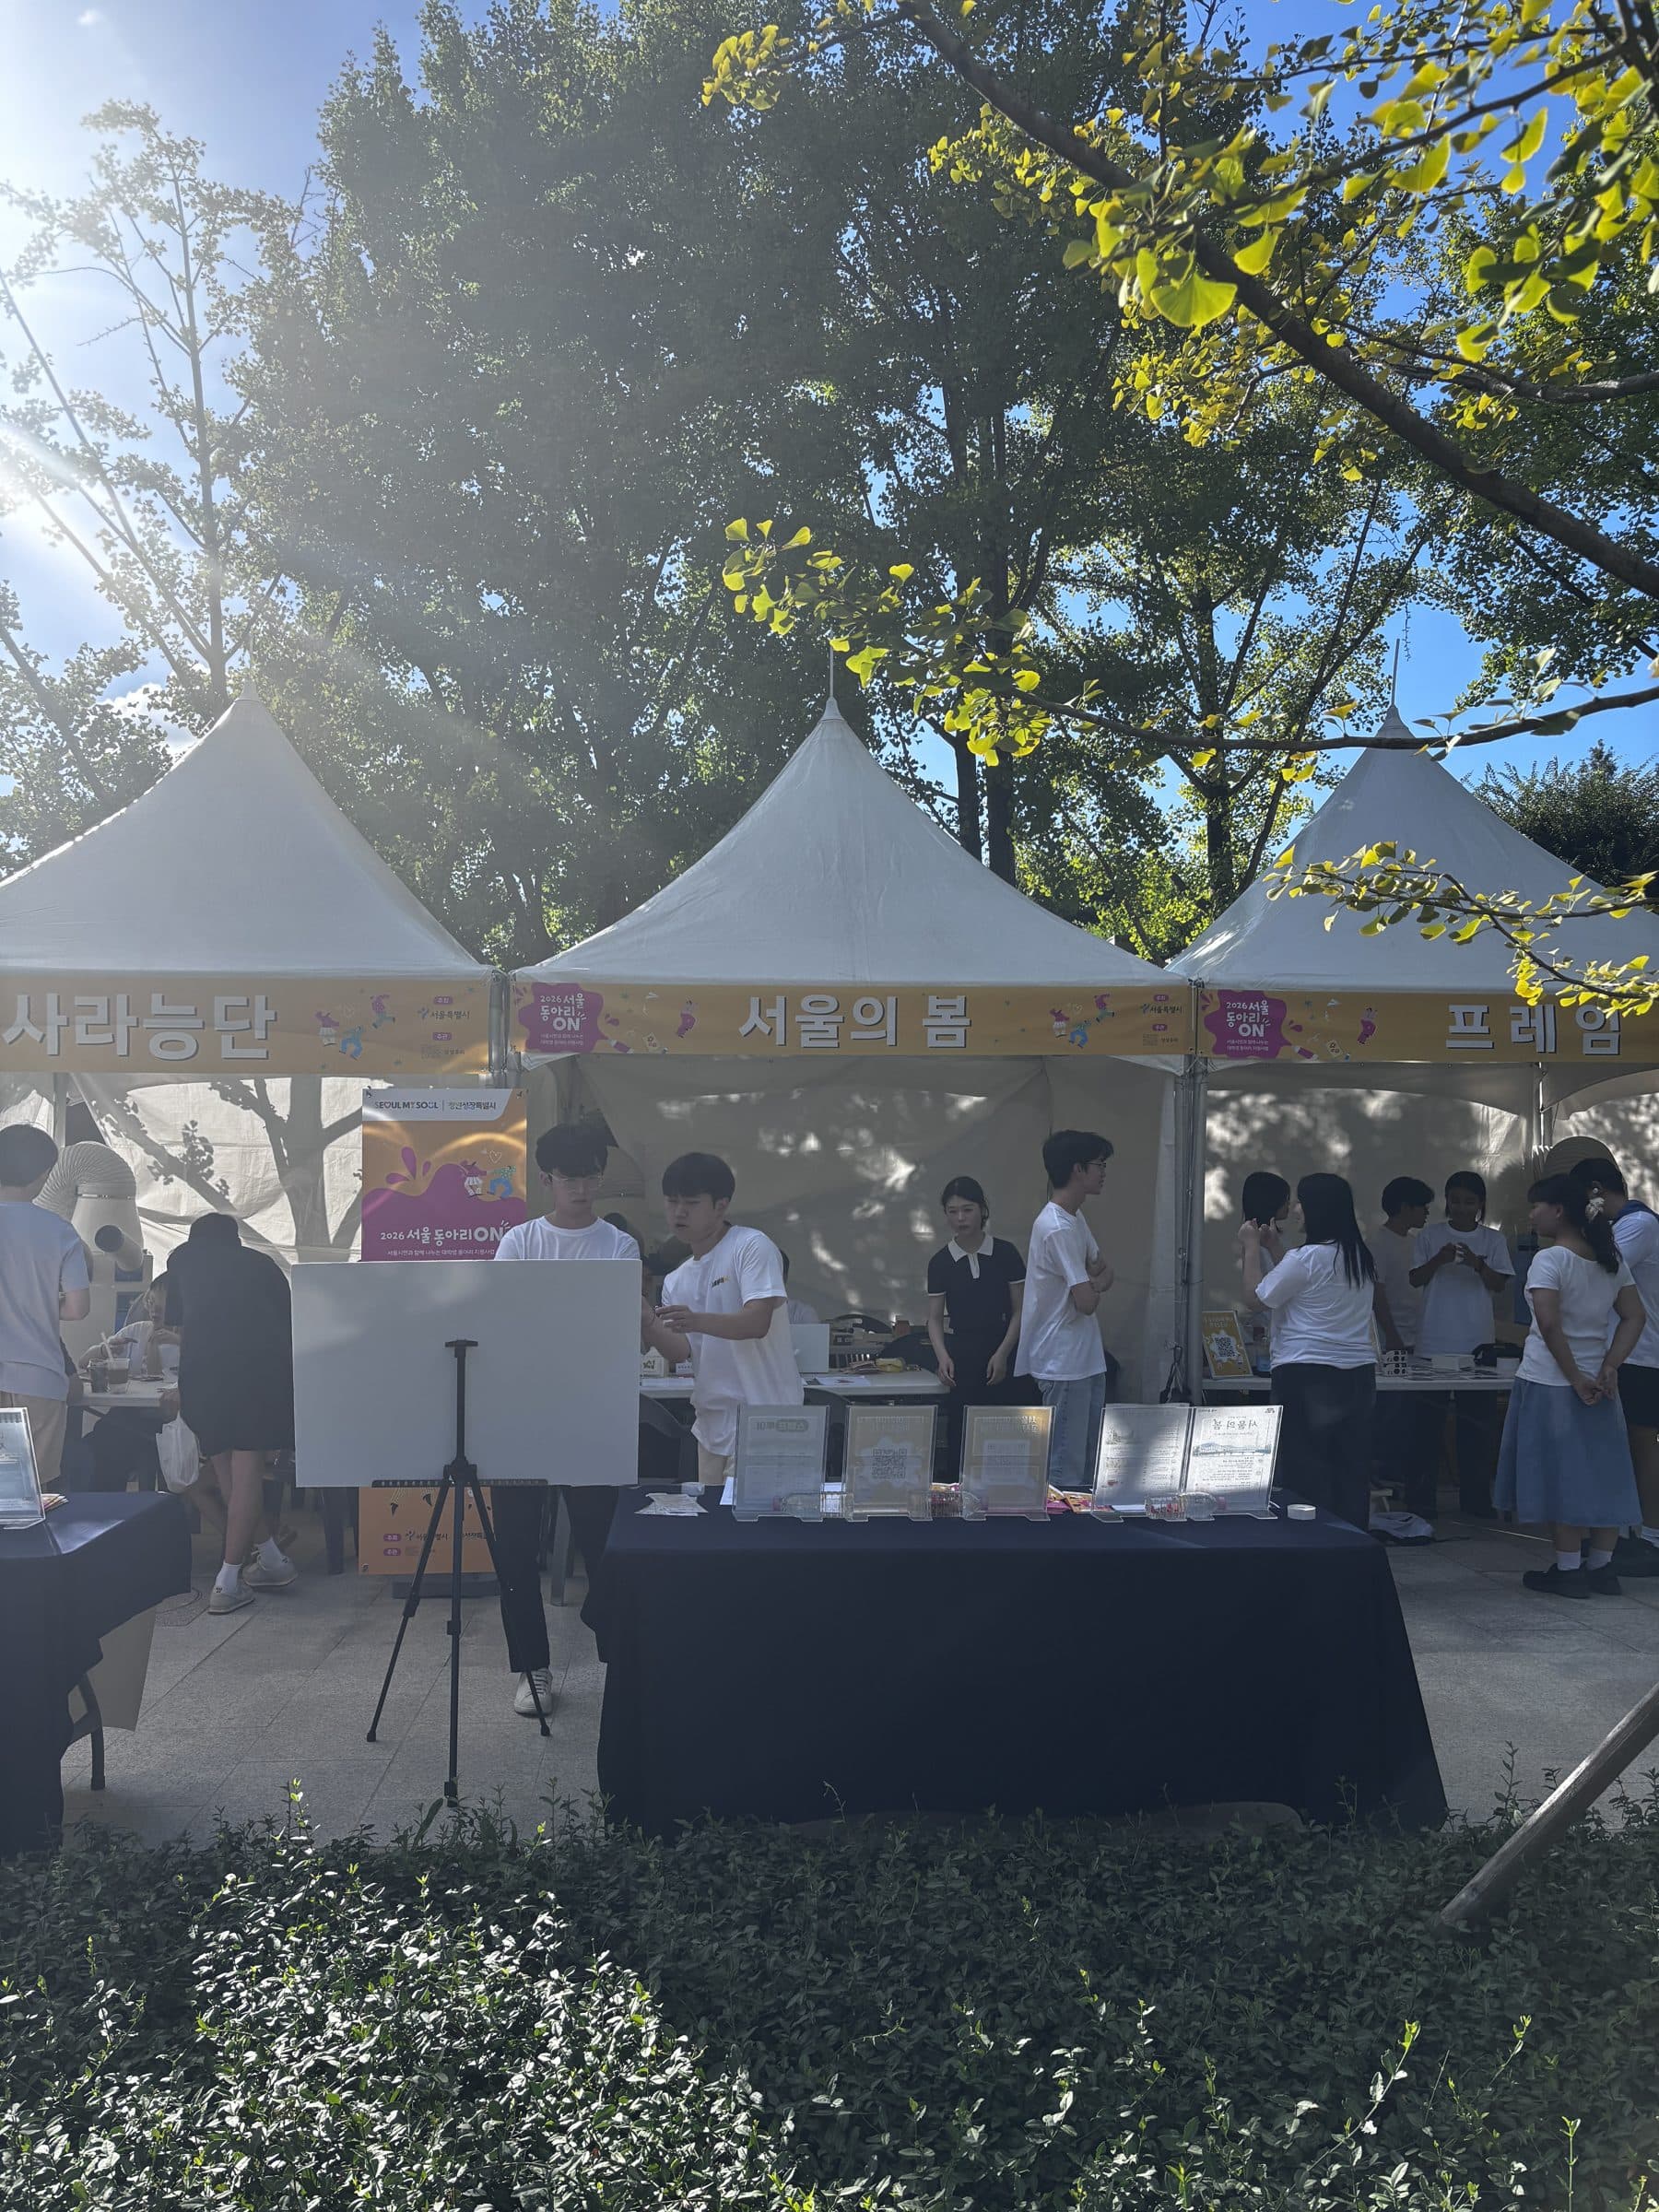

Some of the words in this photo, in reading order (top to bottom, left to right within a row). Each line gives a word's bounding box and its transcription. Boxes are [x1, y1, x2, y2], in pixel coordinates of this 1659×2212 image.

[540, 994, 562, 1004] 2026
[563, 992, 585, 1009] 서울
[1226, 1001, 1248, 1009] 2026
[1248, 999, 1269, 1016] 서울
[540, 1005, 575, 1022] 동아리
[739, 994, 899, 1049] 서울의
[922, 994, 972, 1049] 봄
[1226, 1011, 1260, 1029] 동아리
[2, 993, 276, 1061] 사라능단
[552, 1017, 581, 1031] ON
[1238, 1023, 1265, 1038] ON
[1445, 1003, 1620, 1055] 프레임
[380, 1231, 405, 1241] 2026
[406, 1226, 431, 1245] 서울
